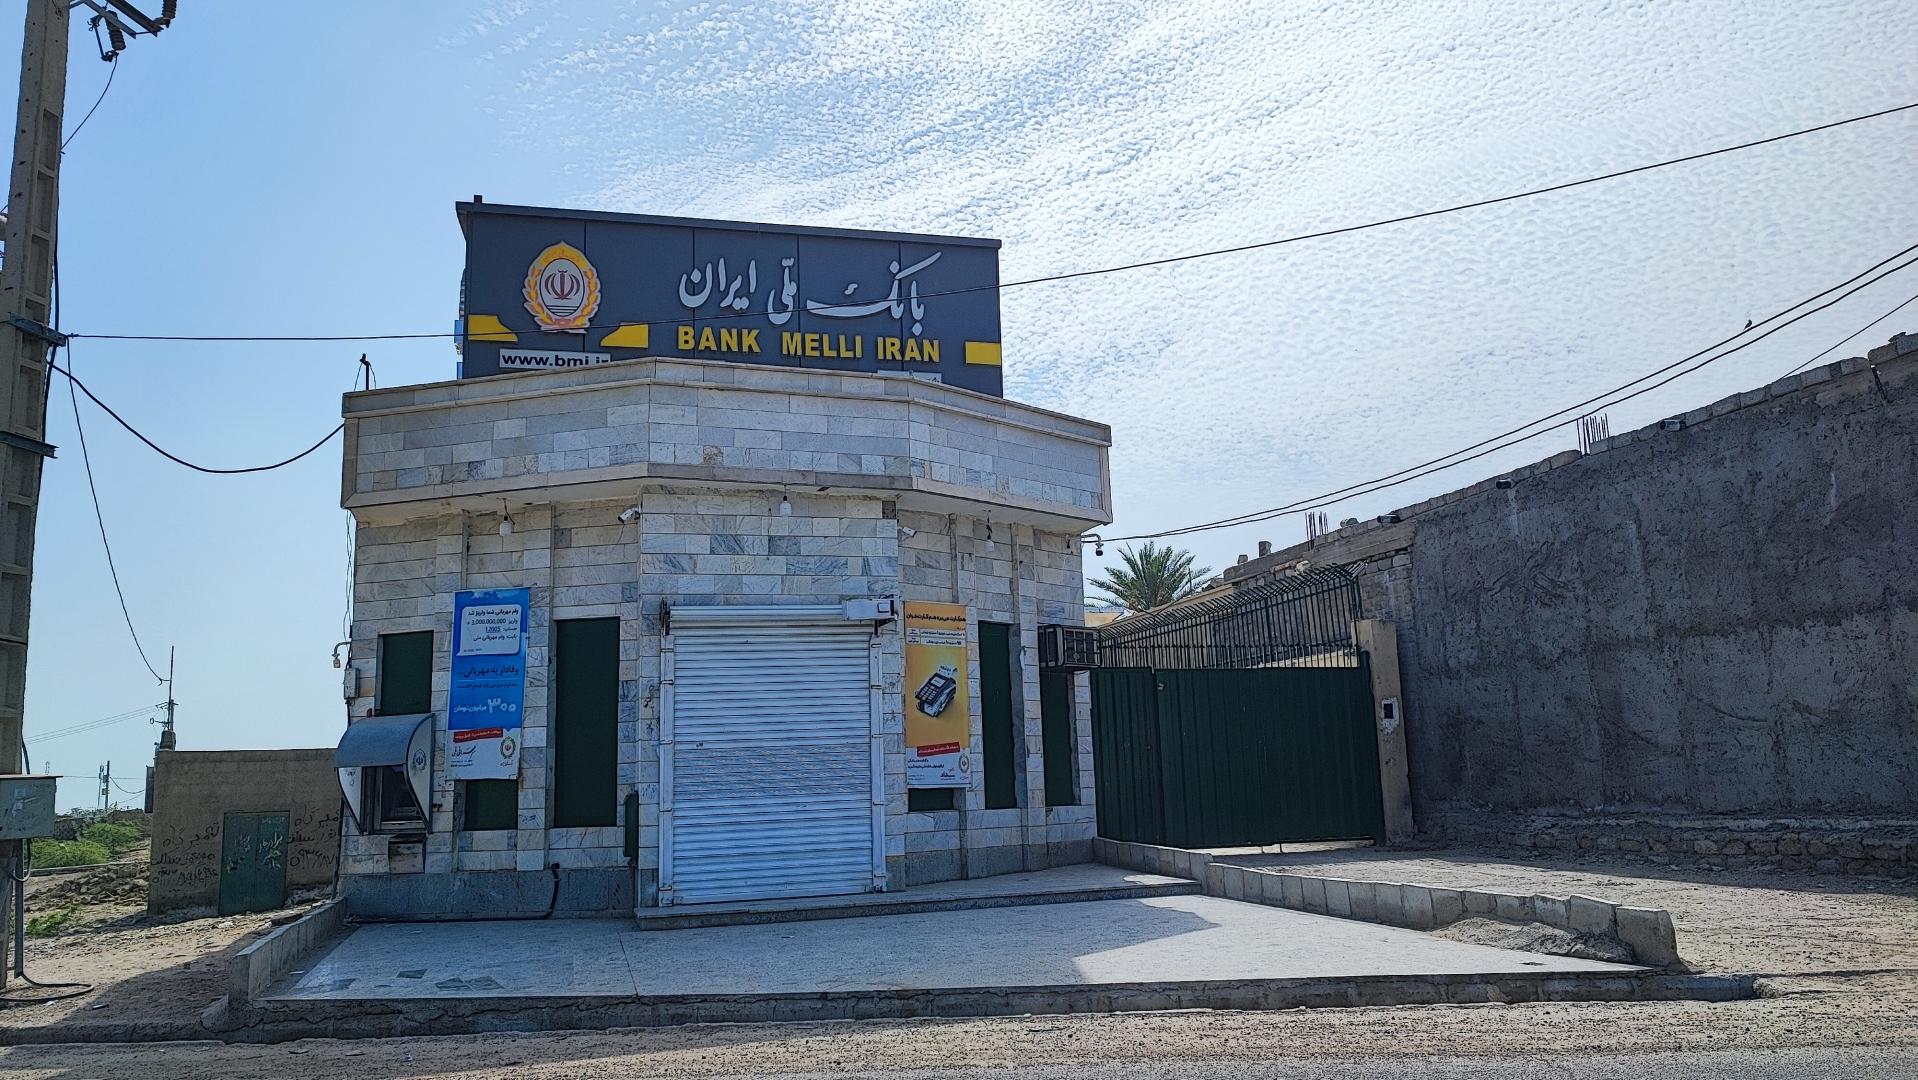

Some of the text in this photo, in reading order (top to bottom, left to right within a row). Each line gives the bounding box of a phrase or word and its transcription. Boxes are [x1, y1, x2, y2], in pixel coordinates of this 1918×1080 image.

[679, 257, 757, 311] ایران
[806, 251, 942, 337] بانک
[501, 354, 609, 367] www.bmii
[677, 325, 940, 363] BANK MELLI IRAN
